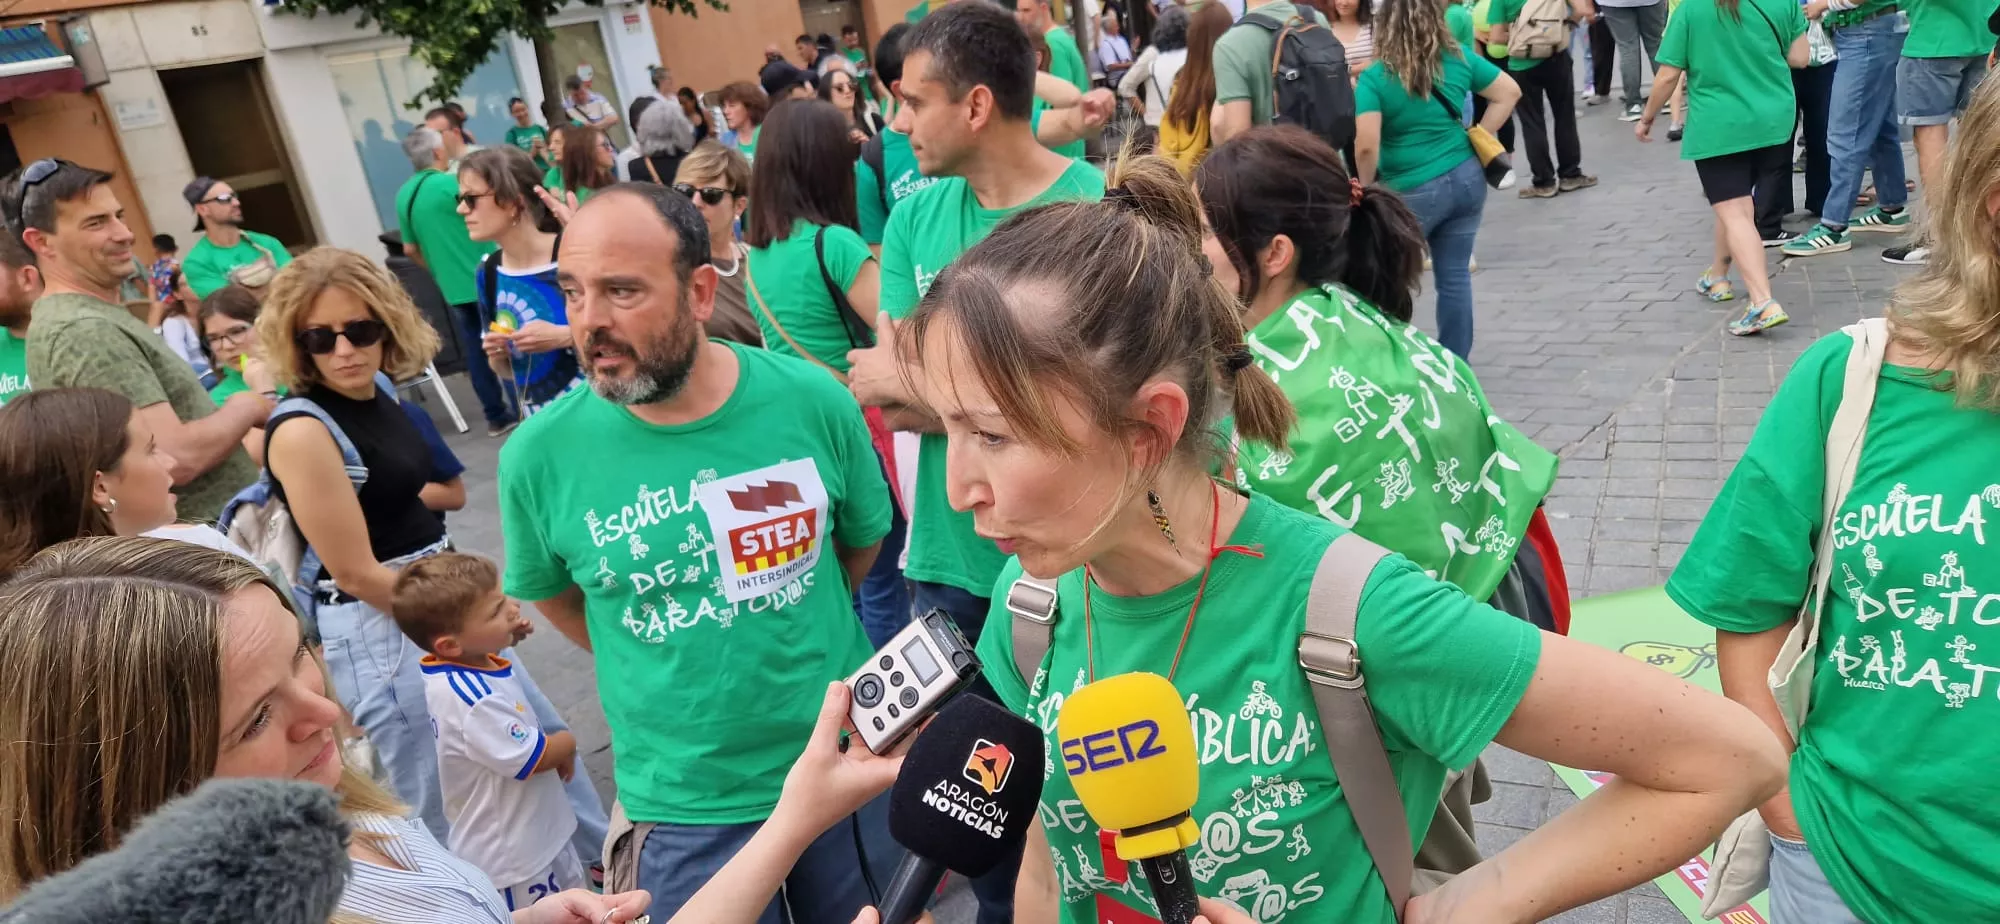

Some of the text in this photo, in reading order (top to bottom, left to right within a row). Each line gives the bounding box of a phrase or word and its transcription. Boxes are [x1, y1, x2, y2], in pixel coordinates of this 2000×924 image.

[191, 25, 208, 36] 85
[589, 481, 708, 546] ESCUELA
[1832, 493, 1987, 550] ESCUELA
[740, 518, 811, 556] STEA
[629, 559, 678, 596] DE
[736, 552, 815, 591] INTERSINDICAL
[624, 597, 718, 637] PARA
[1856, 587, 1916, 623] DE
[1835, 646, 1948, 694] PARA
[1844, 677, 1886, 691] Huesca
[1062, 719, 1167, 777] SER
[922, 789, 1005, 841] NOTICIAS
[934, 779, 1009, 824] ARAGÓN
[1040, 798, 1087, 834] DE
